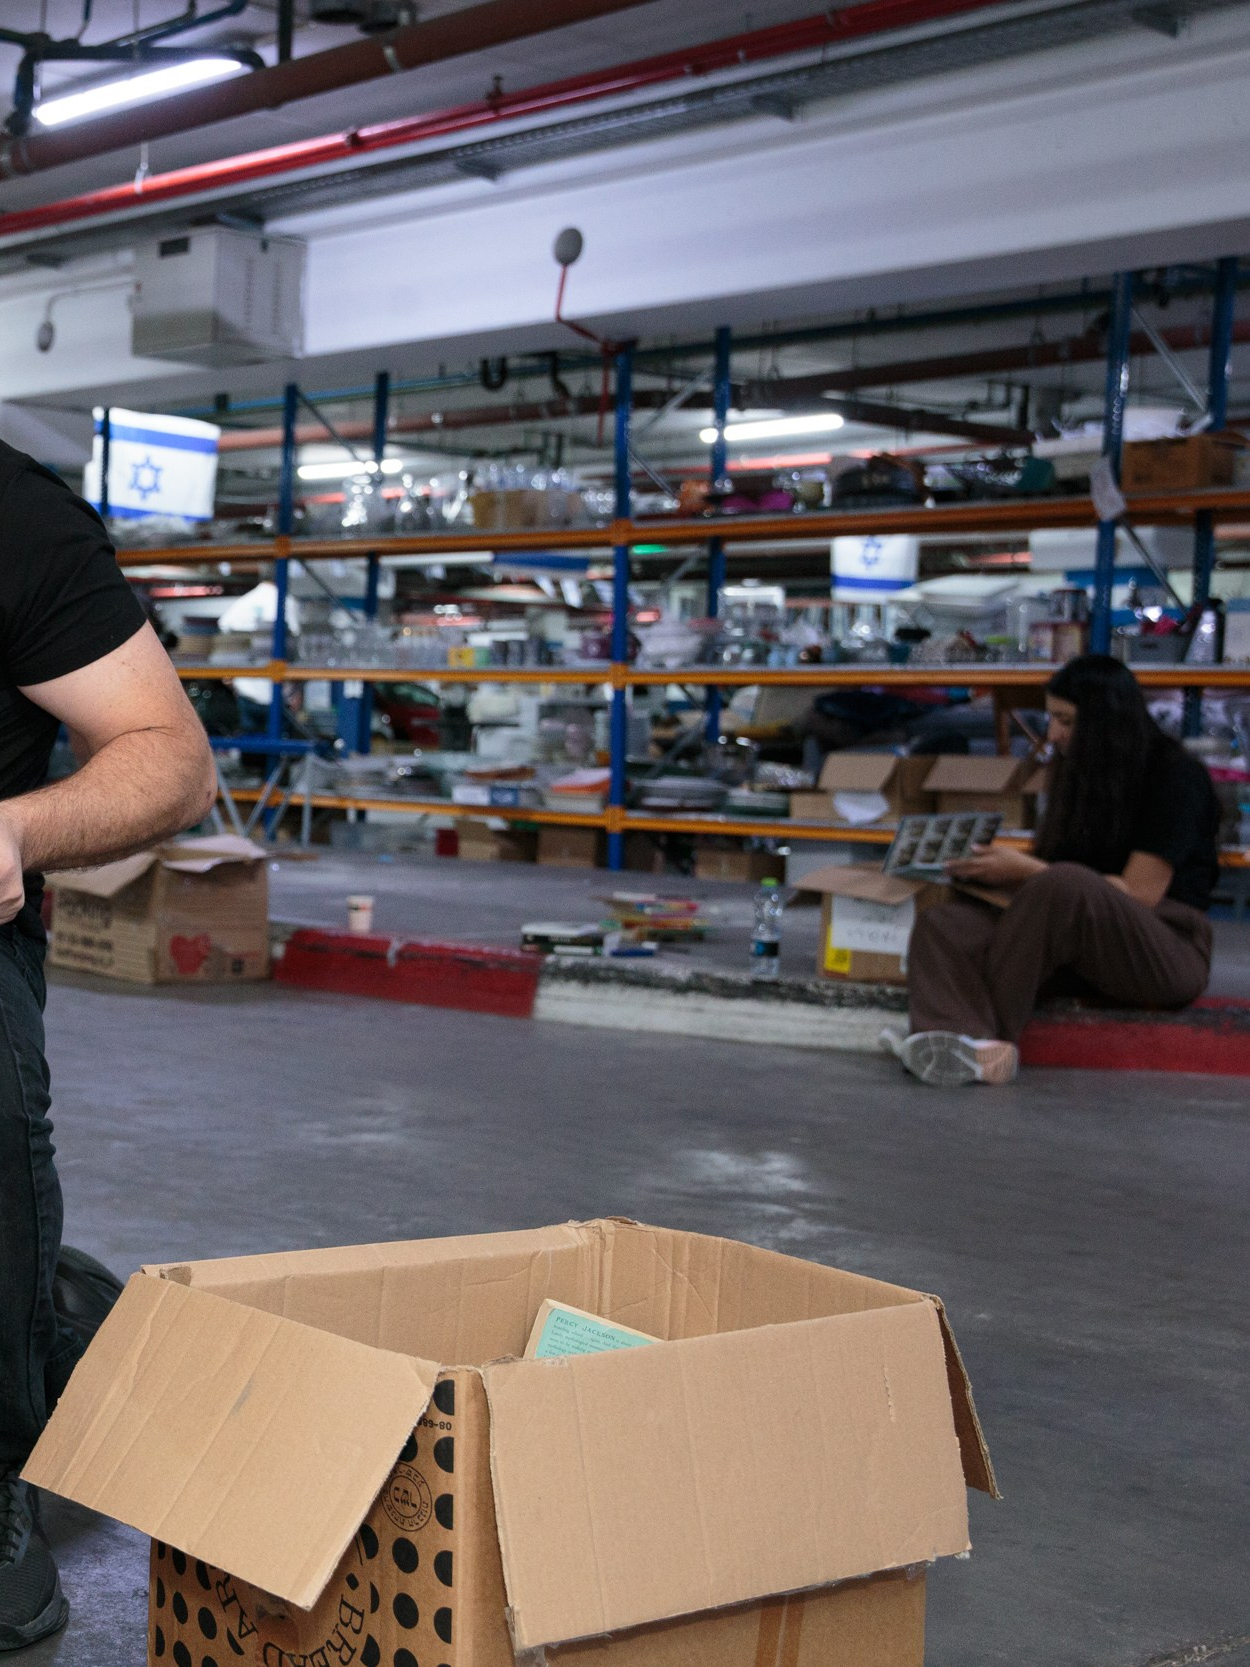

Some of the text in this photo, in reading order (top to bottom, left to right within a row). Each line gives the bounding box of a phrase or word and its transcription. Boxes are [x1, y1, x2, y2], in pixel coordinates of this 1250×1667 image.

[556, 1316, 616, 1341] PERCY JACKSON
[393, 1486, 418, 1509] כשר
